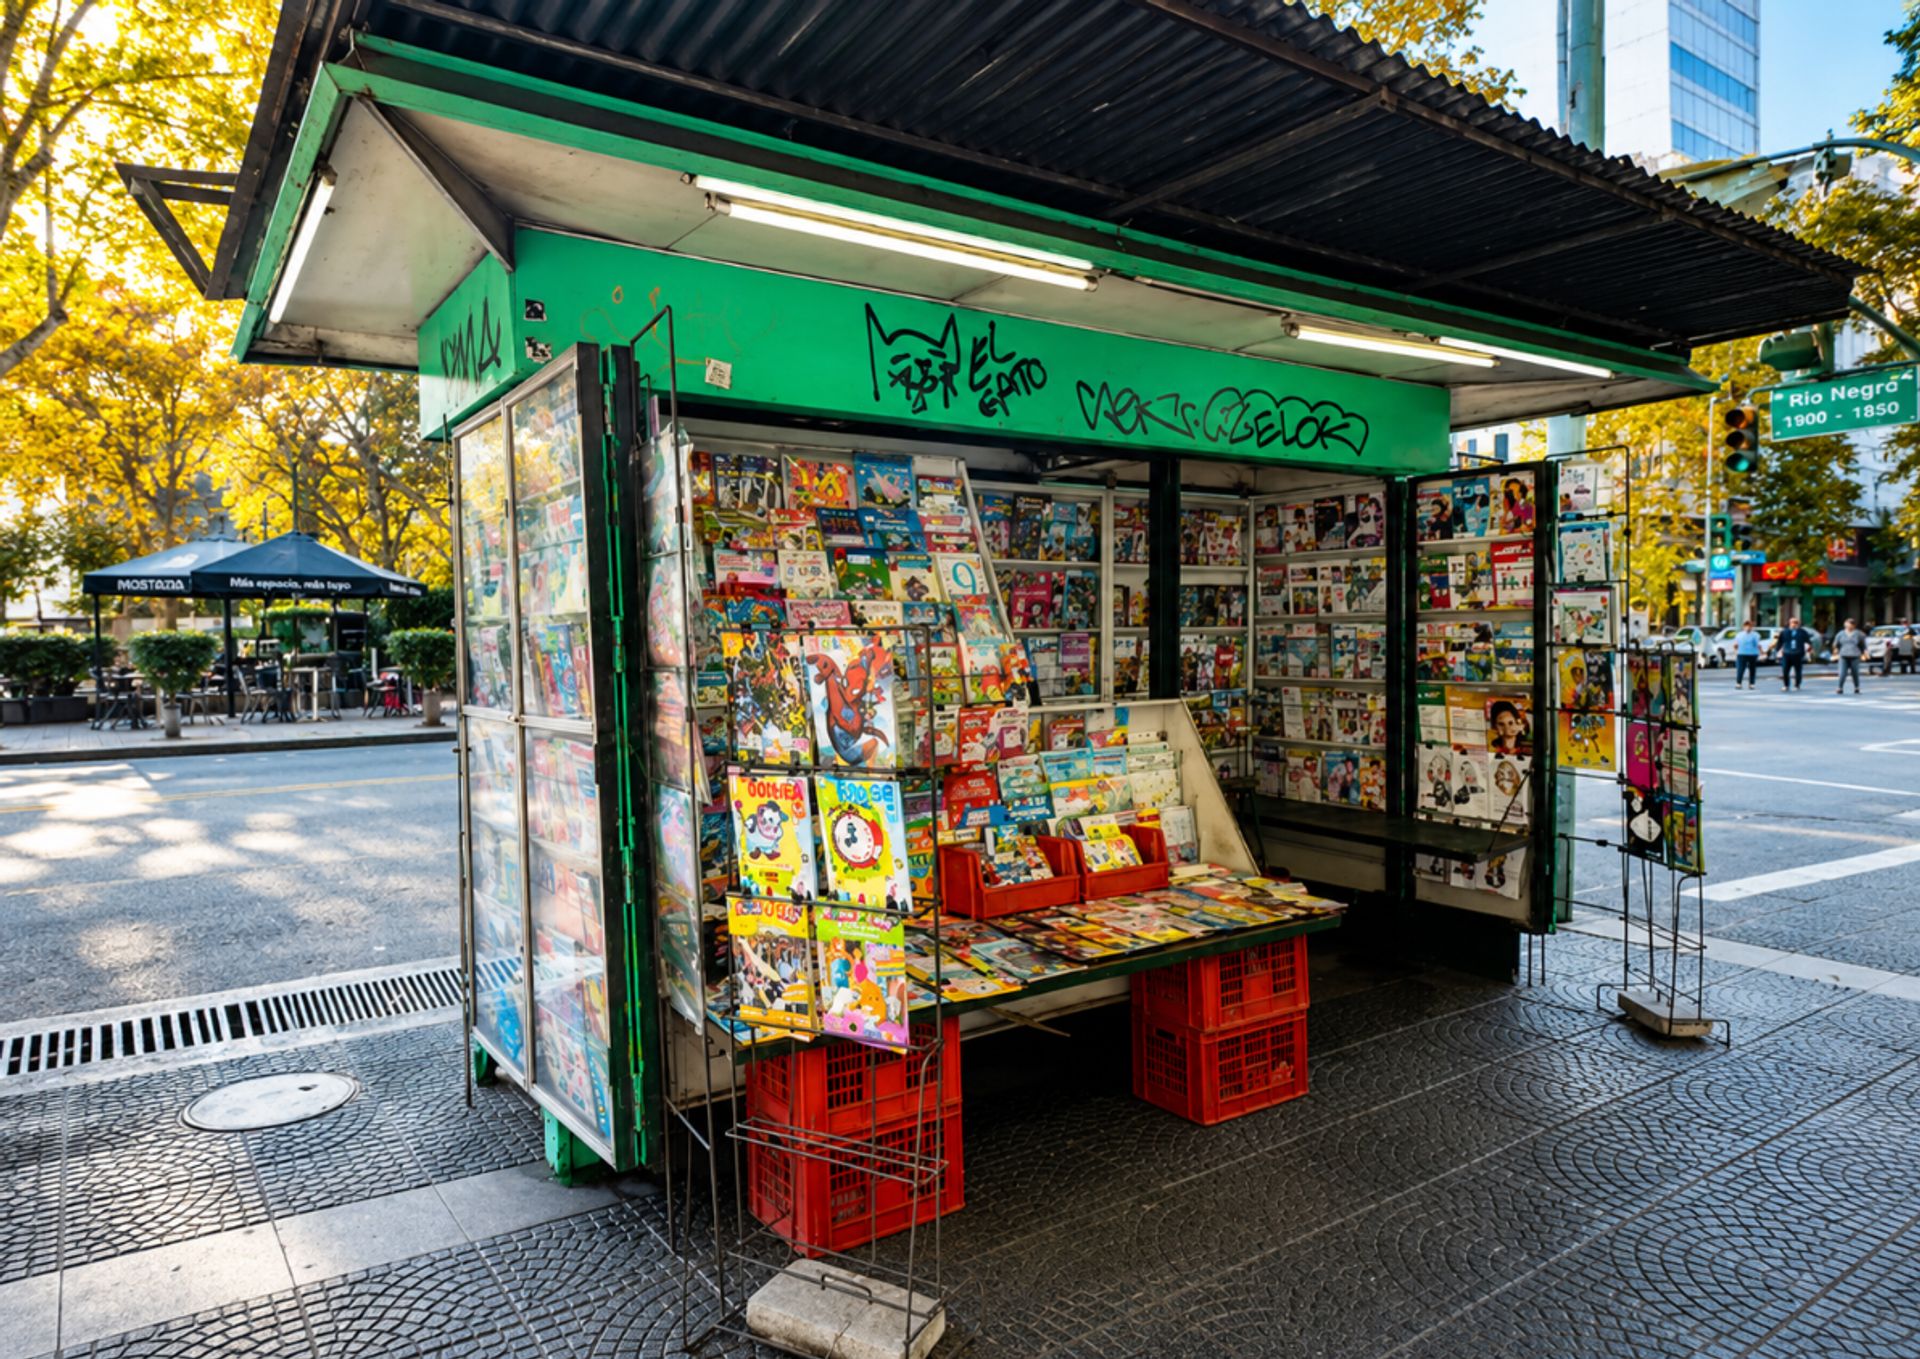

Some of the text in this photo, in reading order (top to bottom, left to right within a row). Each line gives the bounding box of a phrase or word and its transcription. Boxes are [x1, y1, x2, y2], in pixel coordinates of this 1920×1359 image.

[969, 320, 1016, 392] EL
[1782, 411, 1828, 428] 1900
[1852, 402, 1900, 419] 1850
